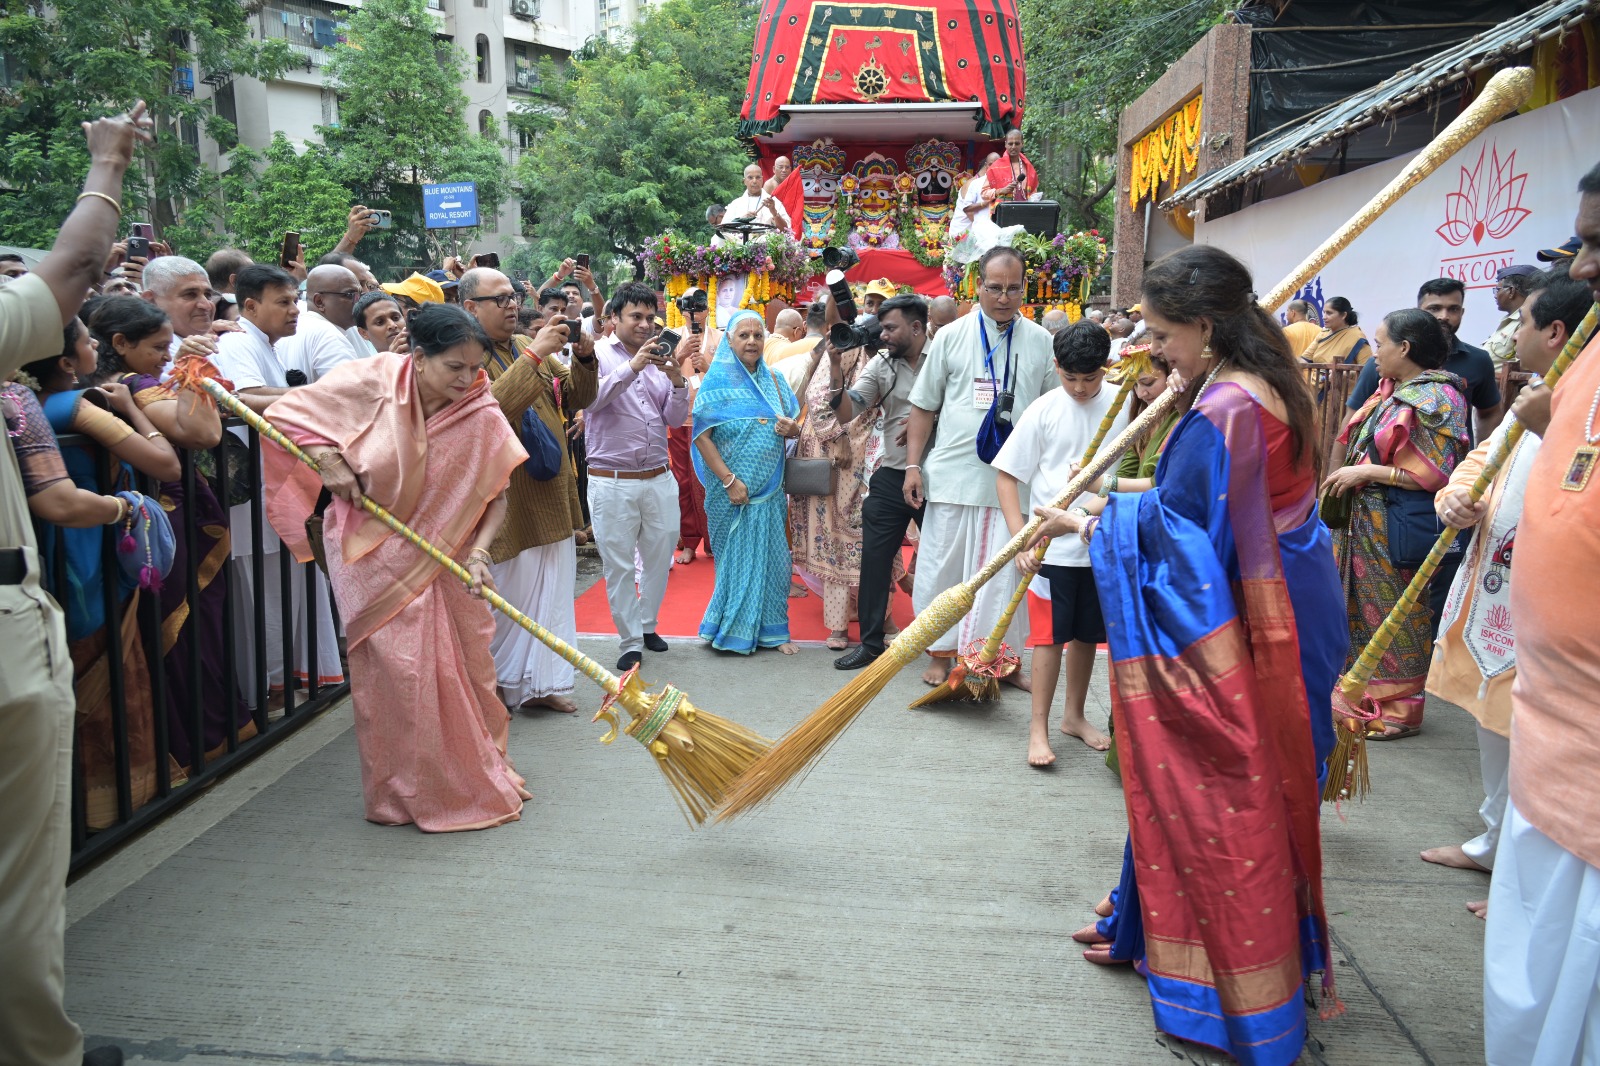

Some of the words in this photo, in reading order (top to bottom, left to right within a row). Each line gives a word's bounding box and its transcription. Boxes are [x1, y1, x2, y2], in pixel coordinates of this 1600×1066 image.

[424, 187, 440, 195] BLUE
[440, 185, 473, 195] MOUNTAINS
[429, 212, 449, 220] ROYAL
[449, 210, 472, 219] RESORT
[1480, 628, 1515, 648] ISKCON
[1483, 643, 1506, 657] JUHU
